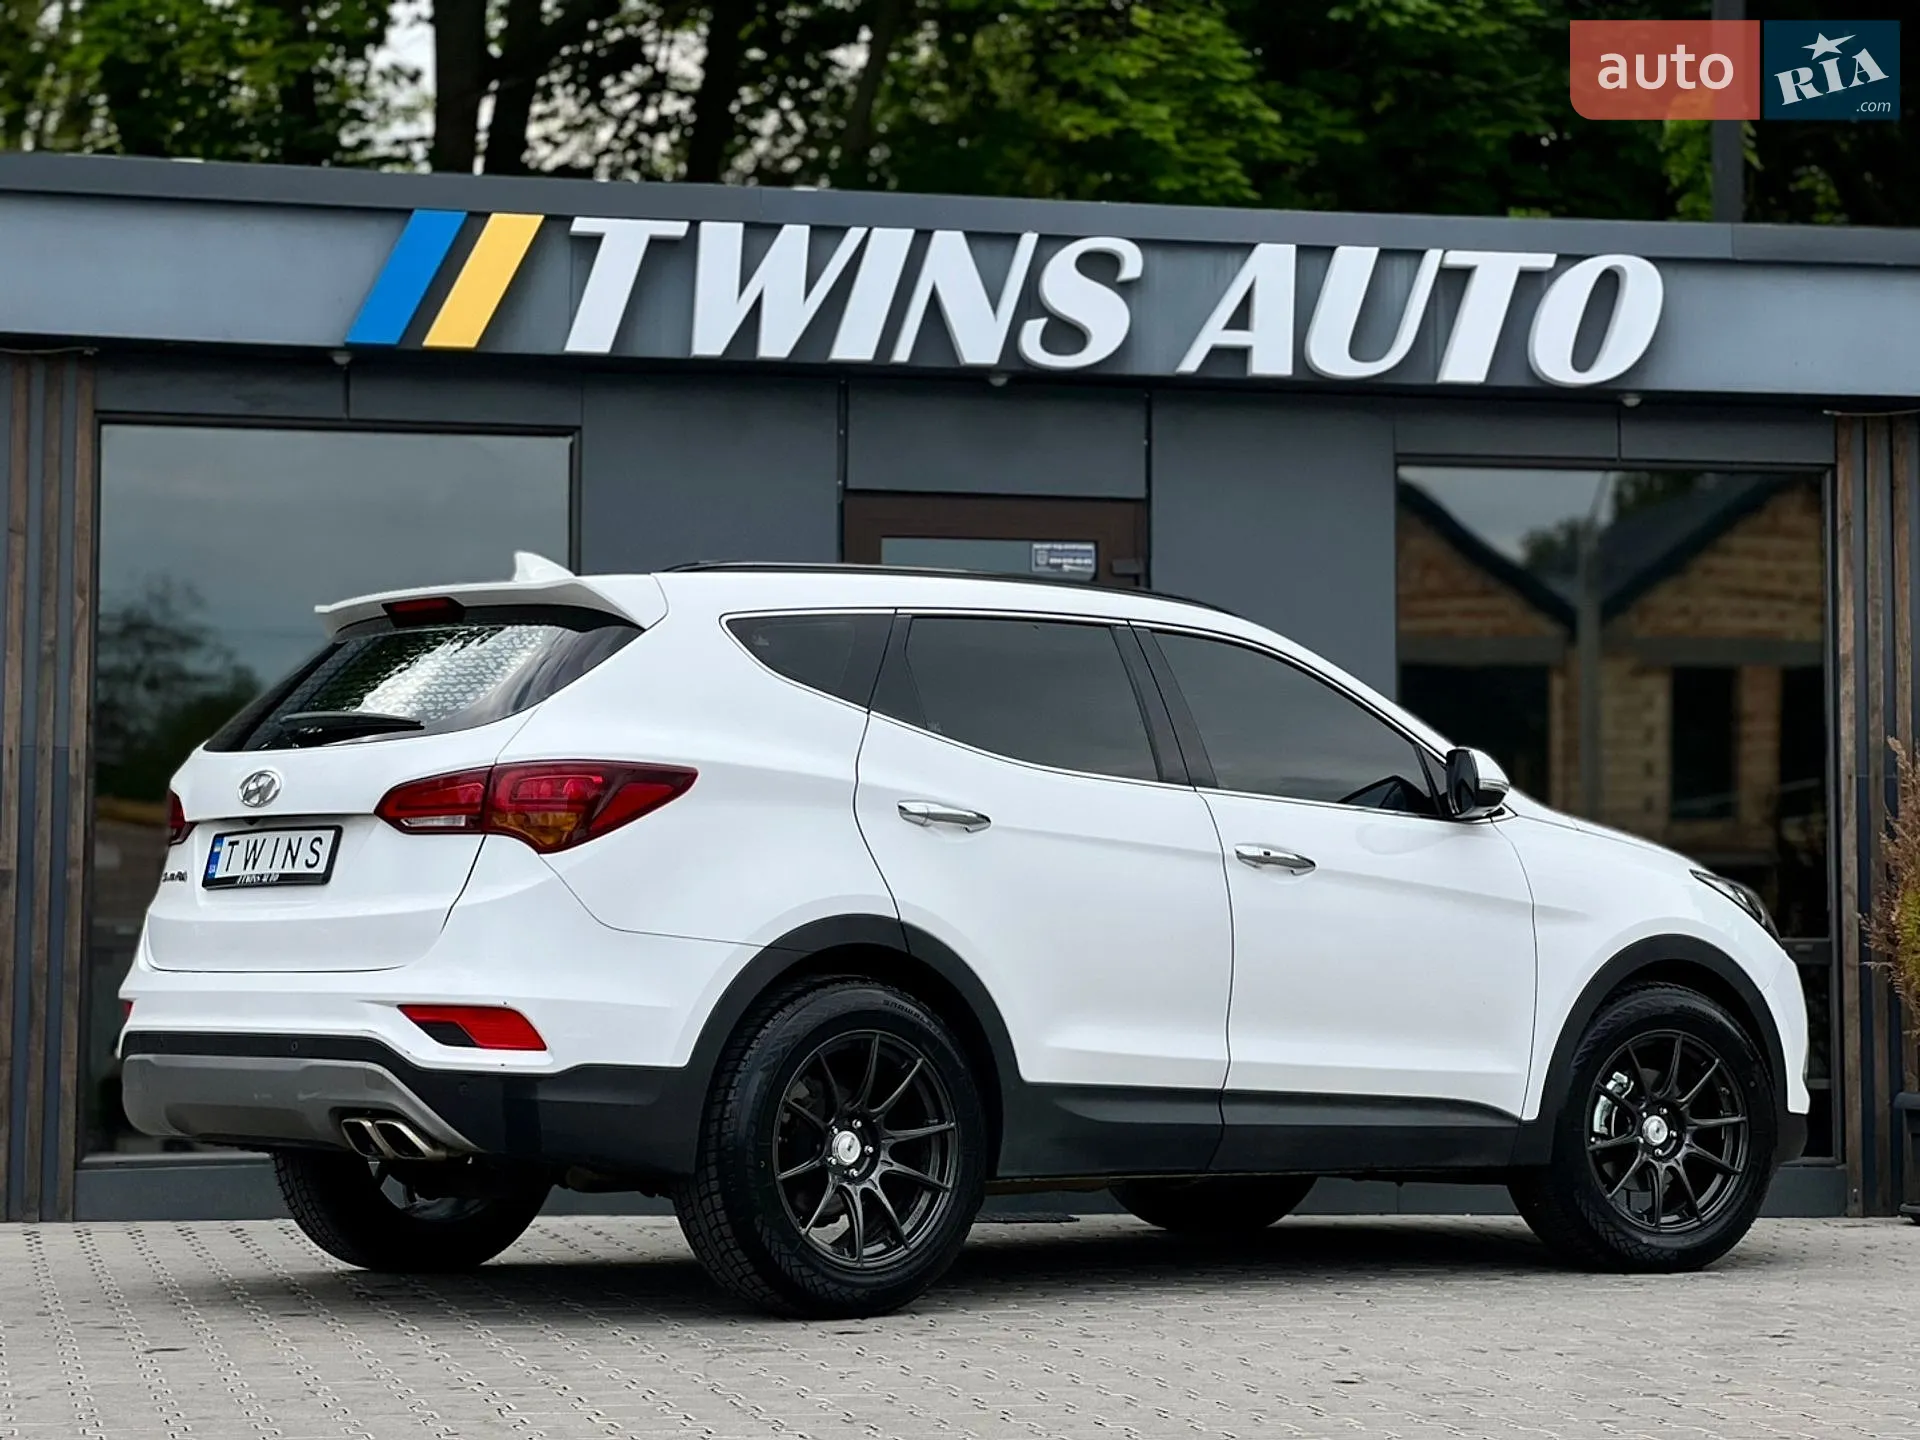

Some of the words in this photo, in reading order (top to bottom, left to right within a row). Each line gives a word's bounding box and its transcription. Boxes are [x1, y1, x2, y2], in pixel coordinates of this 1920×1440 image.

[563, 216, 1143, 368] TWINS
[1176, 242, 1665, 386] AUTO
[224, 836, 324, 872] TWINS
